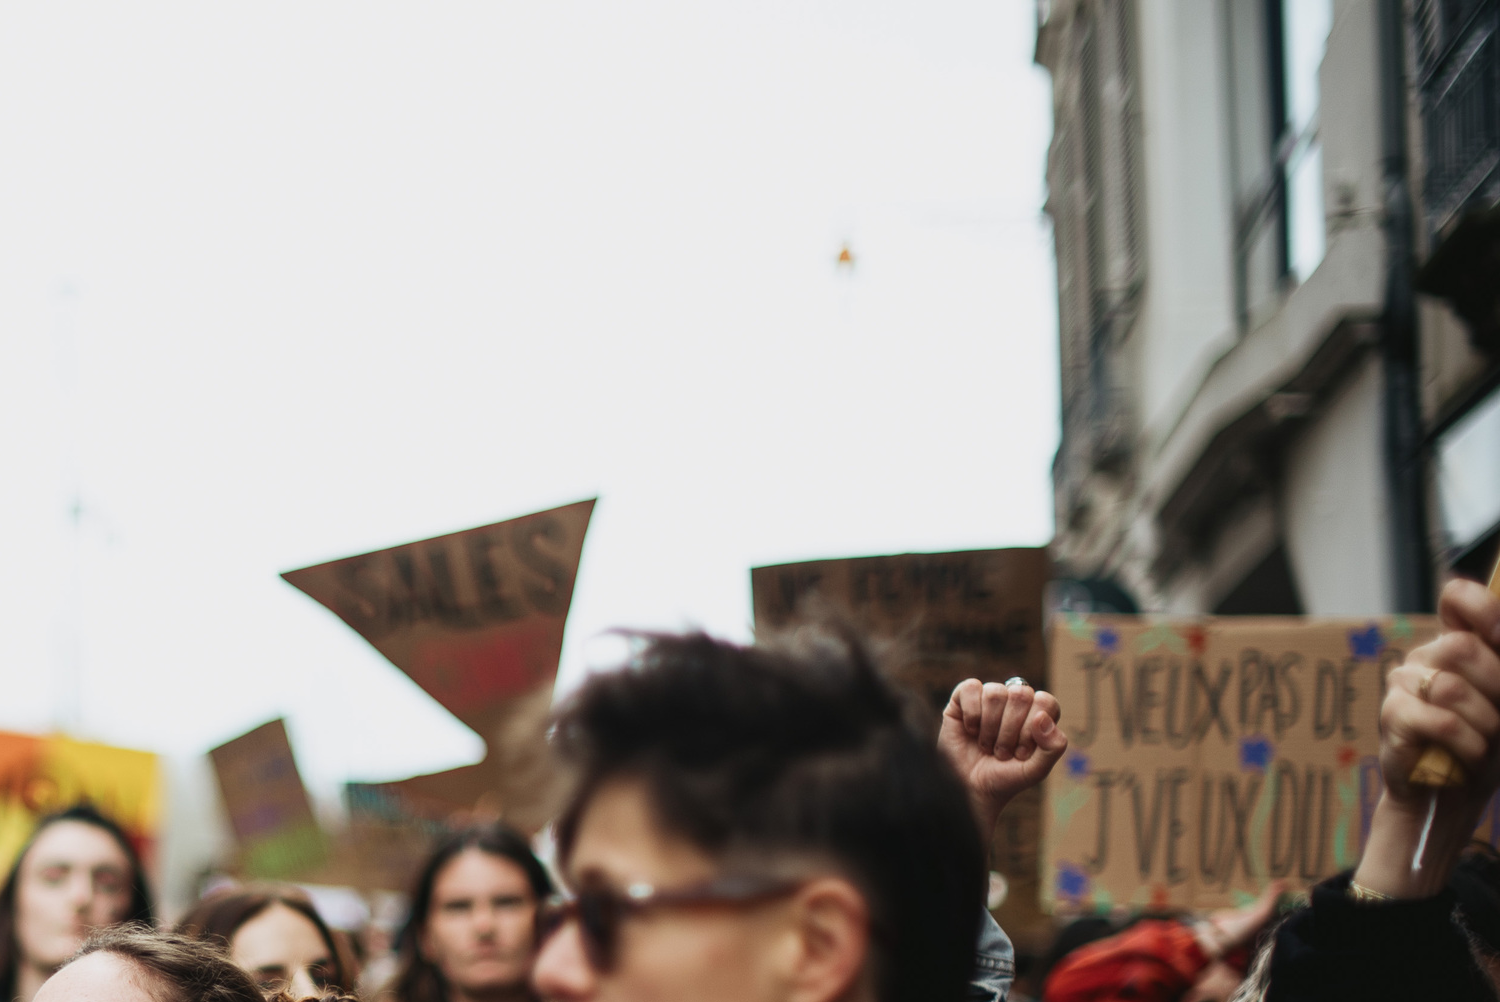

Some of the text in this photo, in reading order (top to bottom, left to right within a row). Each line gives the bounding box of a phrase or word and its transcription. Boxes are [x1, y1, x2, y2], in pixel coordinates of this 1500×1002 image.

[1068, 650, 1233, 750] J'VEUX
[1238, 646, 1304, 740] PAS
[1312, 656, 1360, 742] DE
[1083, 765, 1264, 894] J'VEUX
[1269, 758, 1333, 882] DU
